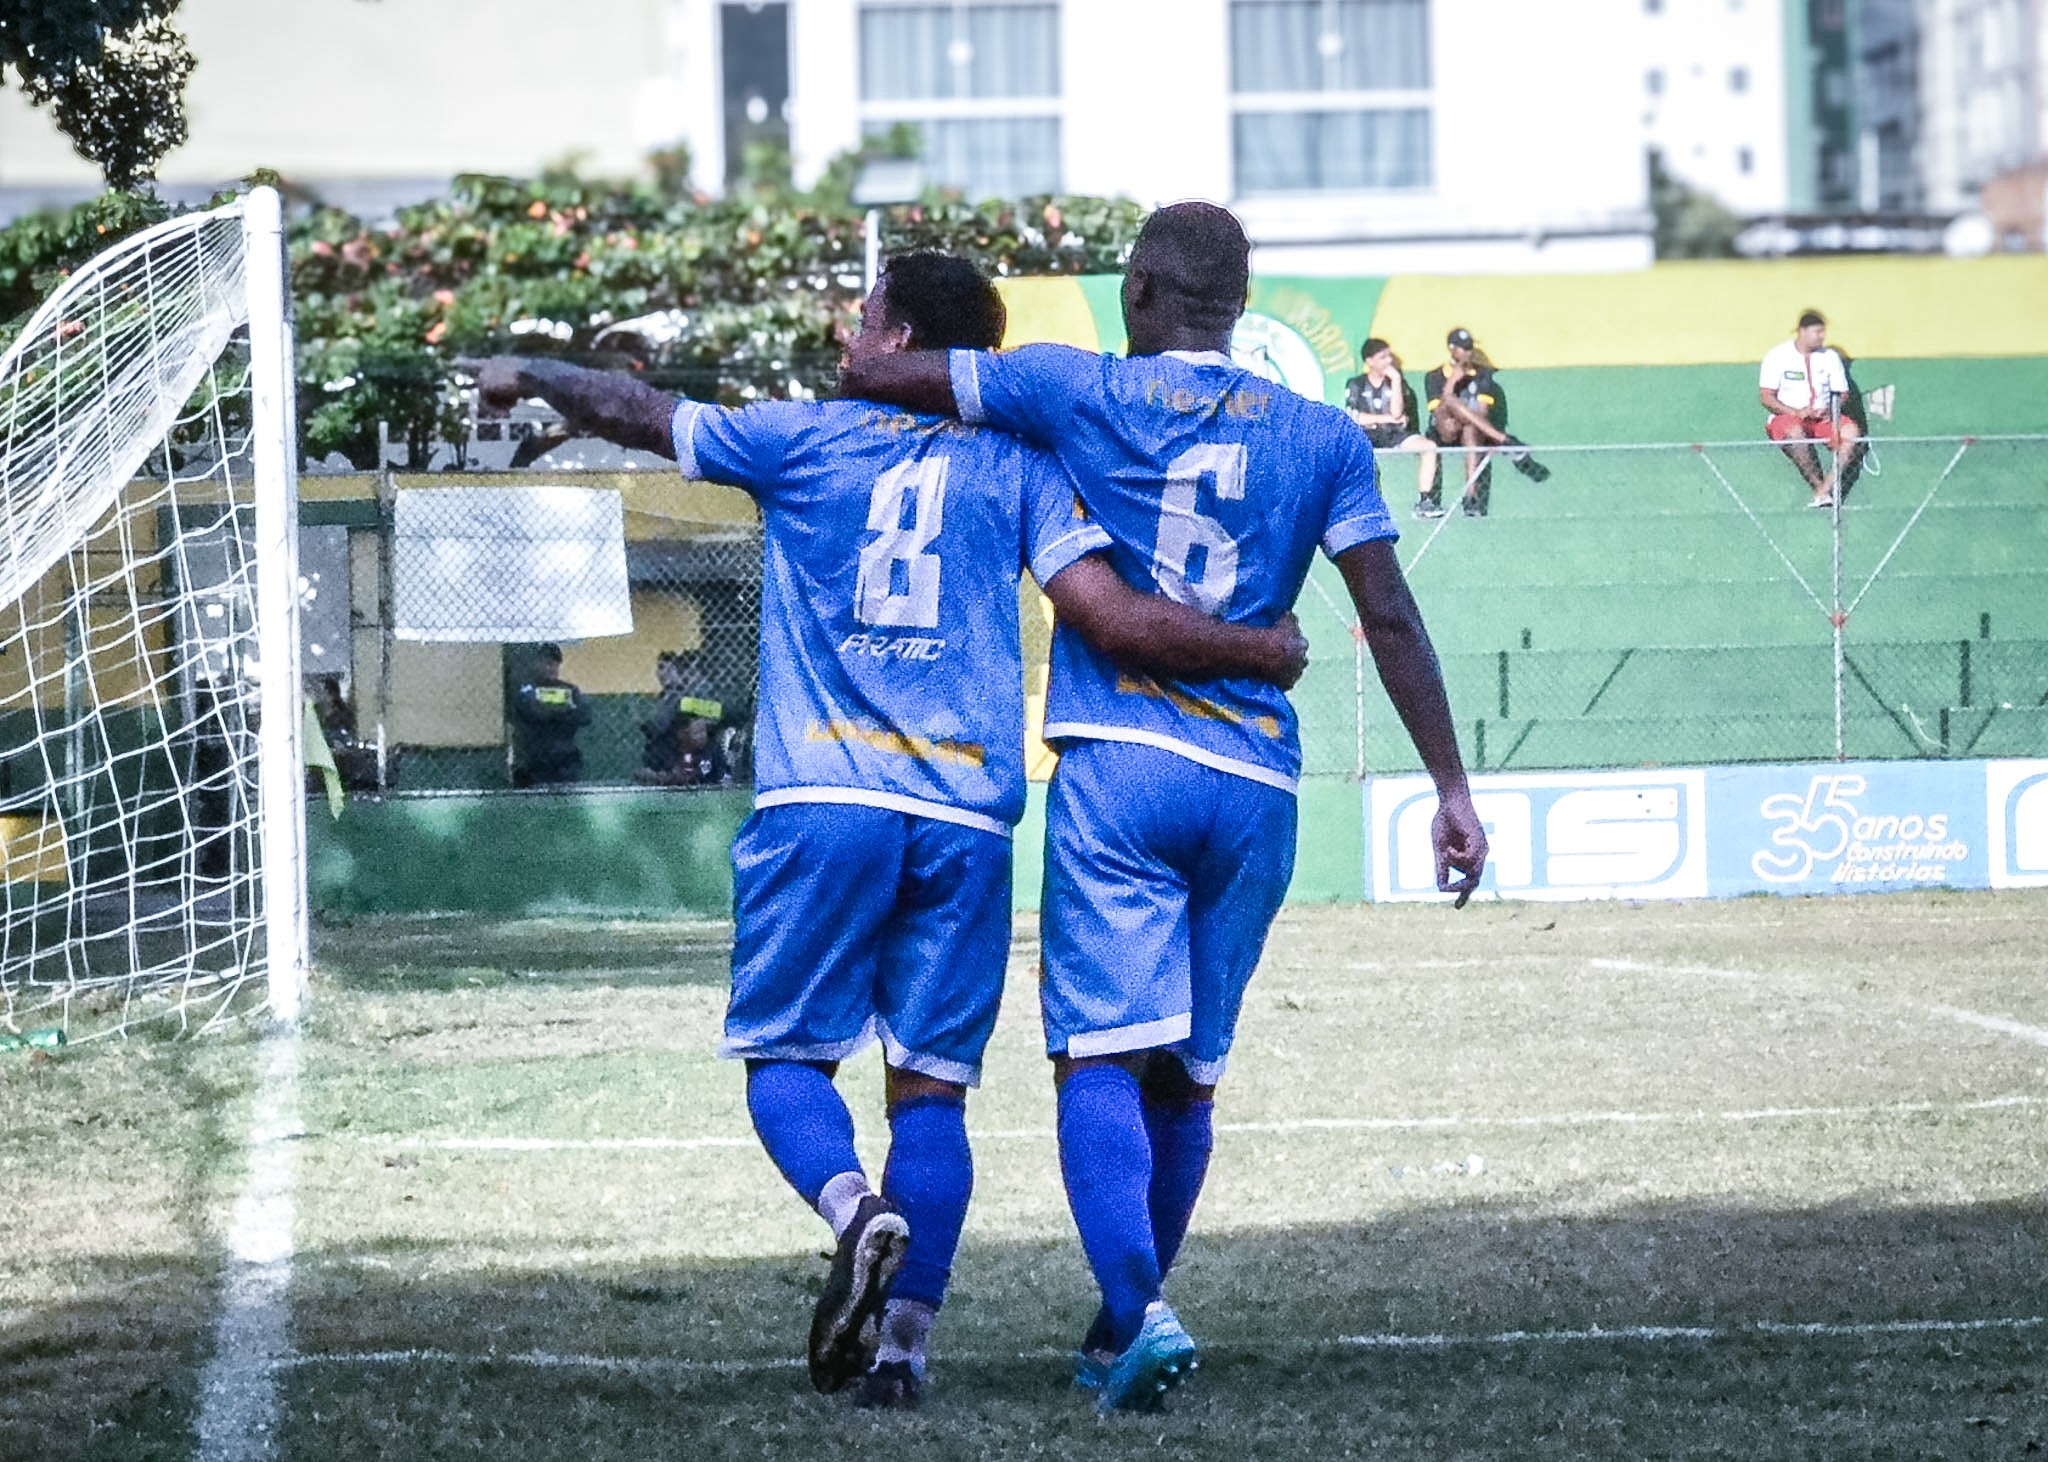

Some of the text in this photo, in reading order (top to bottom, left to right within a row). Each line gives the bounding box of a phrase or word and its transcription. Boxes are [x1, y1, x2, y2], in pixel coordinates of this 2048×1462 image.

[854, 456, 949, 628] 8
[1152, 443, 1248, 615] 6
[1752, 775, 1867, 883] 35
[1852, 814, 1949, 842] anos
